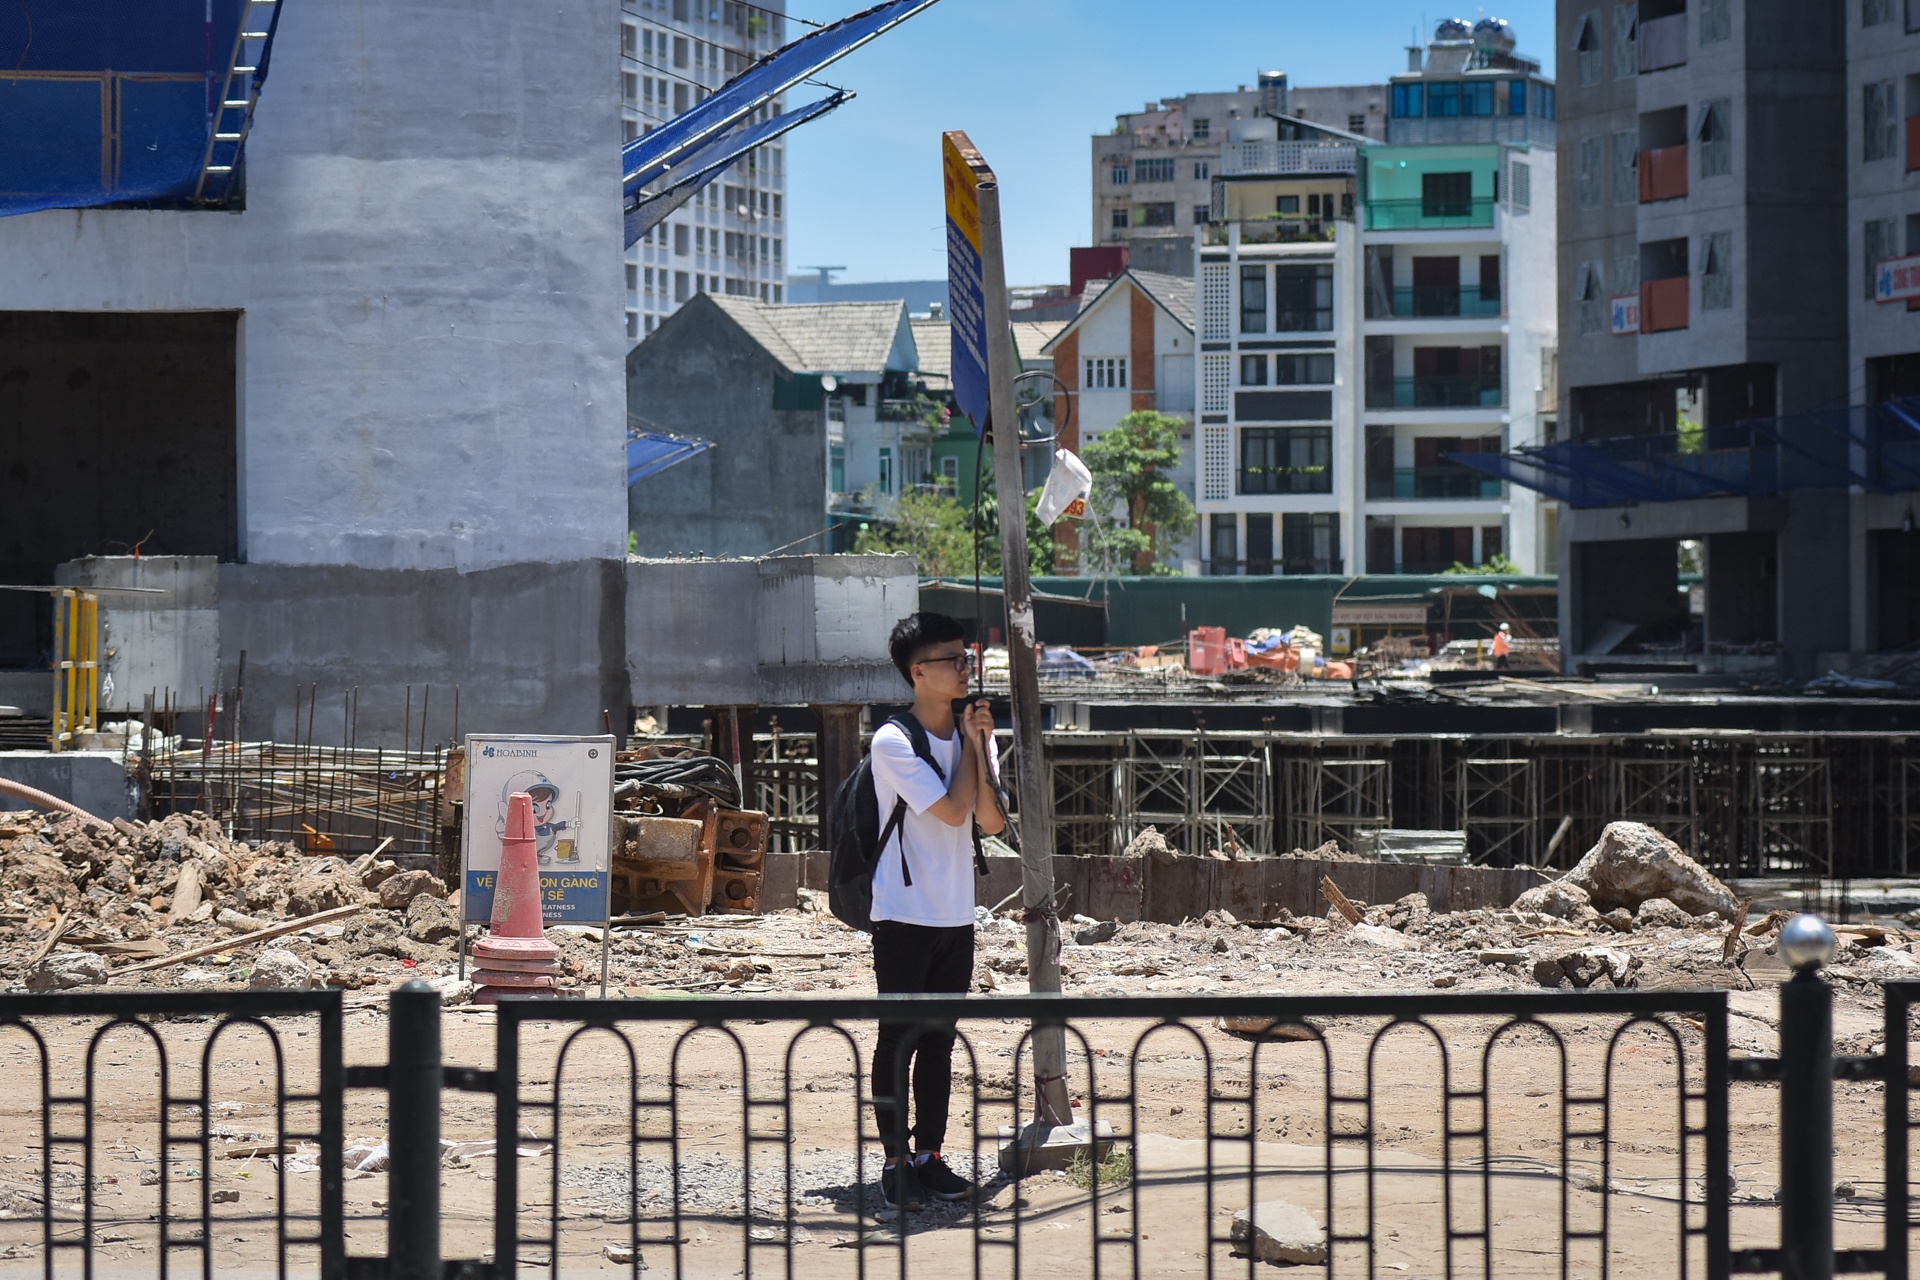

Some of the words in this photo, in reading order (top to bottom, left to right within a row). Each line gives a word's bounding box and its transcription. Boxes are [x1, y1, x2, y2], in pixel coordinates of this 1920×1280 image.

[476, 875, 493, 889] VỆ
[540, 877, 558, 889] ỌN
[561, 874, 598, 889] GÀNG
[548, 888, 565, 901] SẼ
